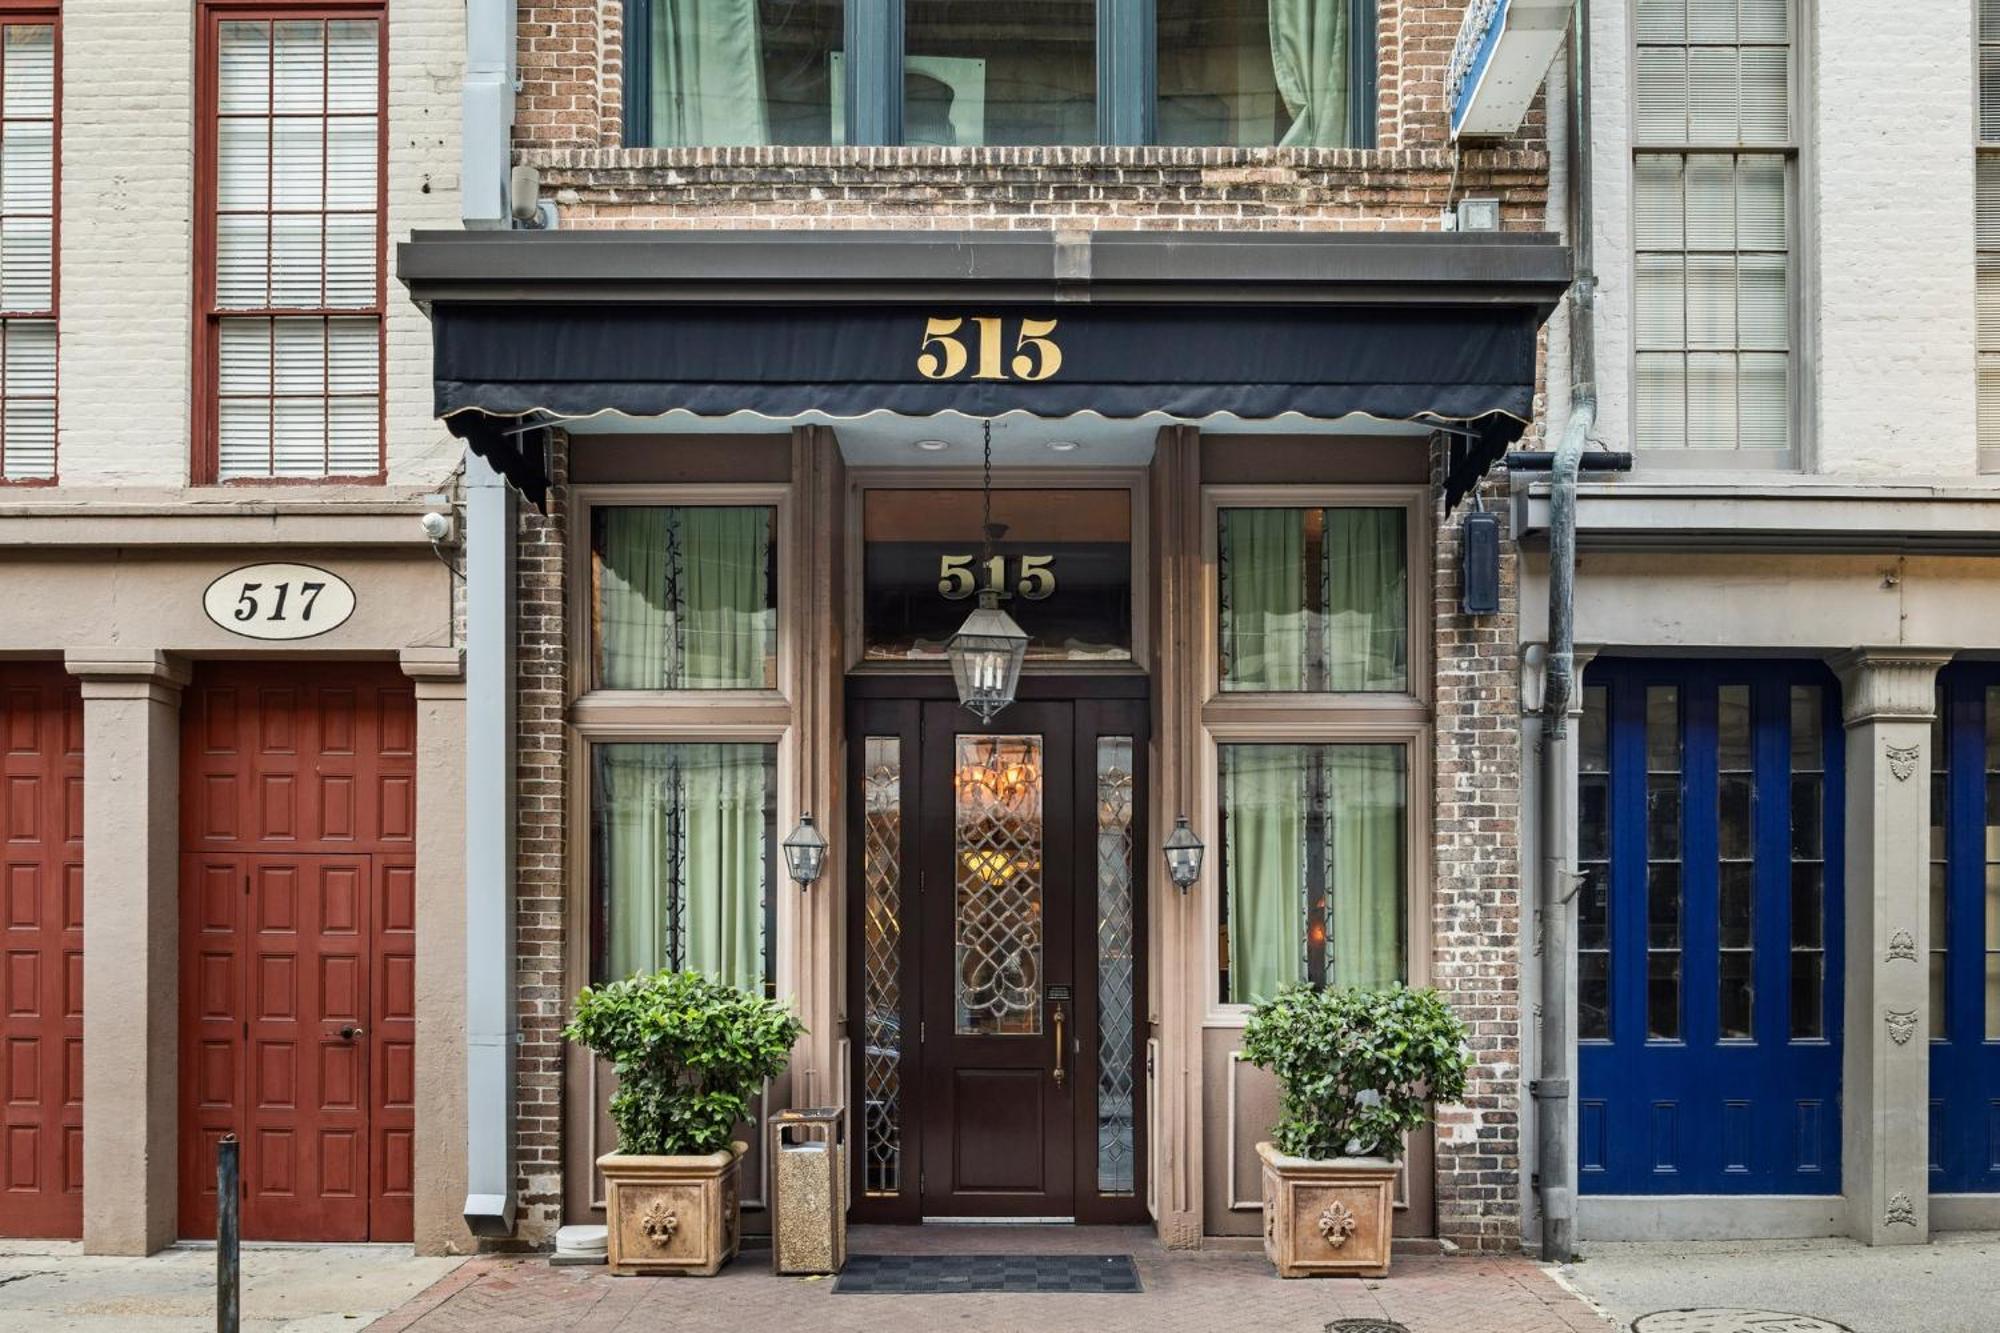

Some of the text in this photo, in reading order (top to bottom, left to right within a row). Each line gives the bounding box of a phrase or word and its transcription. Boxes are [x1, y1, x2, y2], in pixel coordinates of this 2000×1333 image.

[917, 317, 1062, 381] 515
[938, 554, 1056, 600] 515
[234, 582, 326, 621] 517
